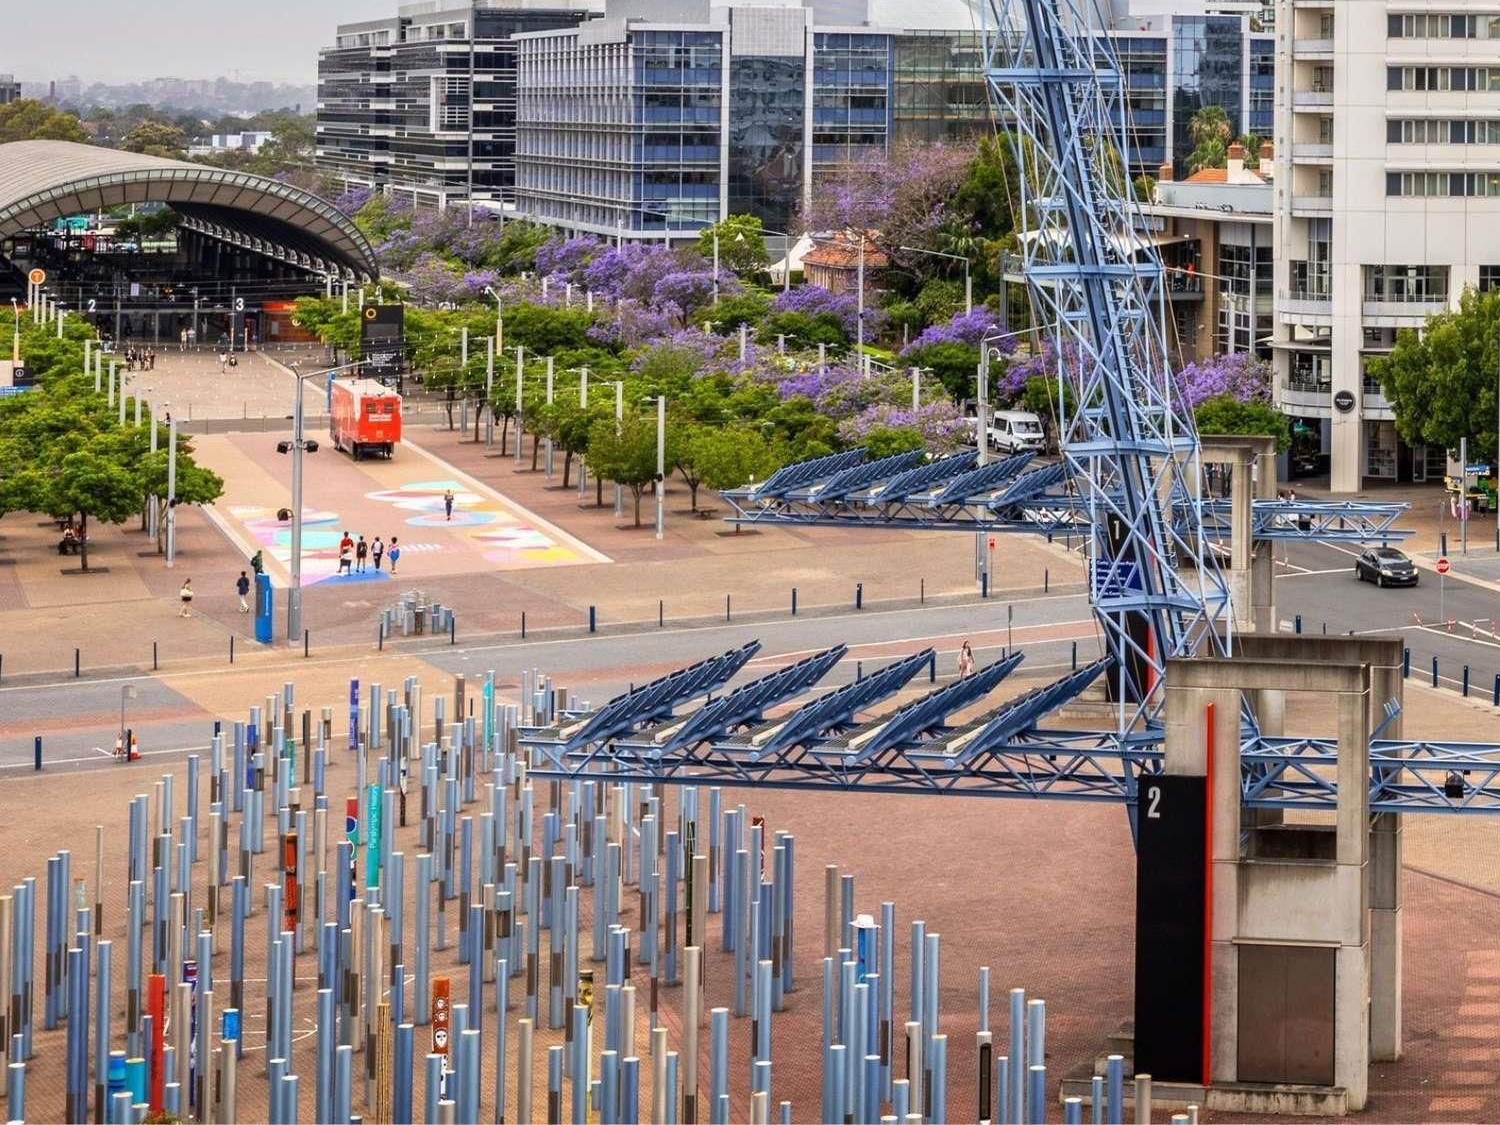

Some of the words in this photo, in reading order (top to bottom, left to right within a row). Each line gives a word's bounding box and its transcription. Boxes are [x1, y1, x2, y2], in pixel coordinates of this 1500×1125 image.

[88, 299, 97, 313] 2
[236, 298, 245, 311] 3
[1113, 520, 1120, 540] 1
[1147, 786, 1160, 818] 2
